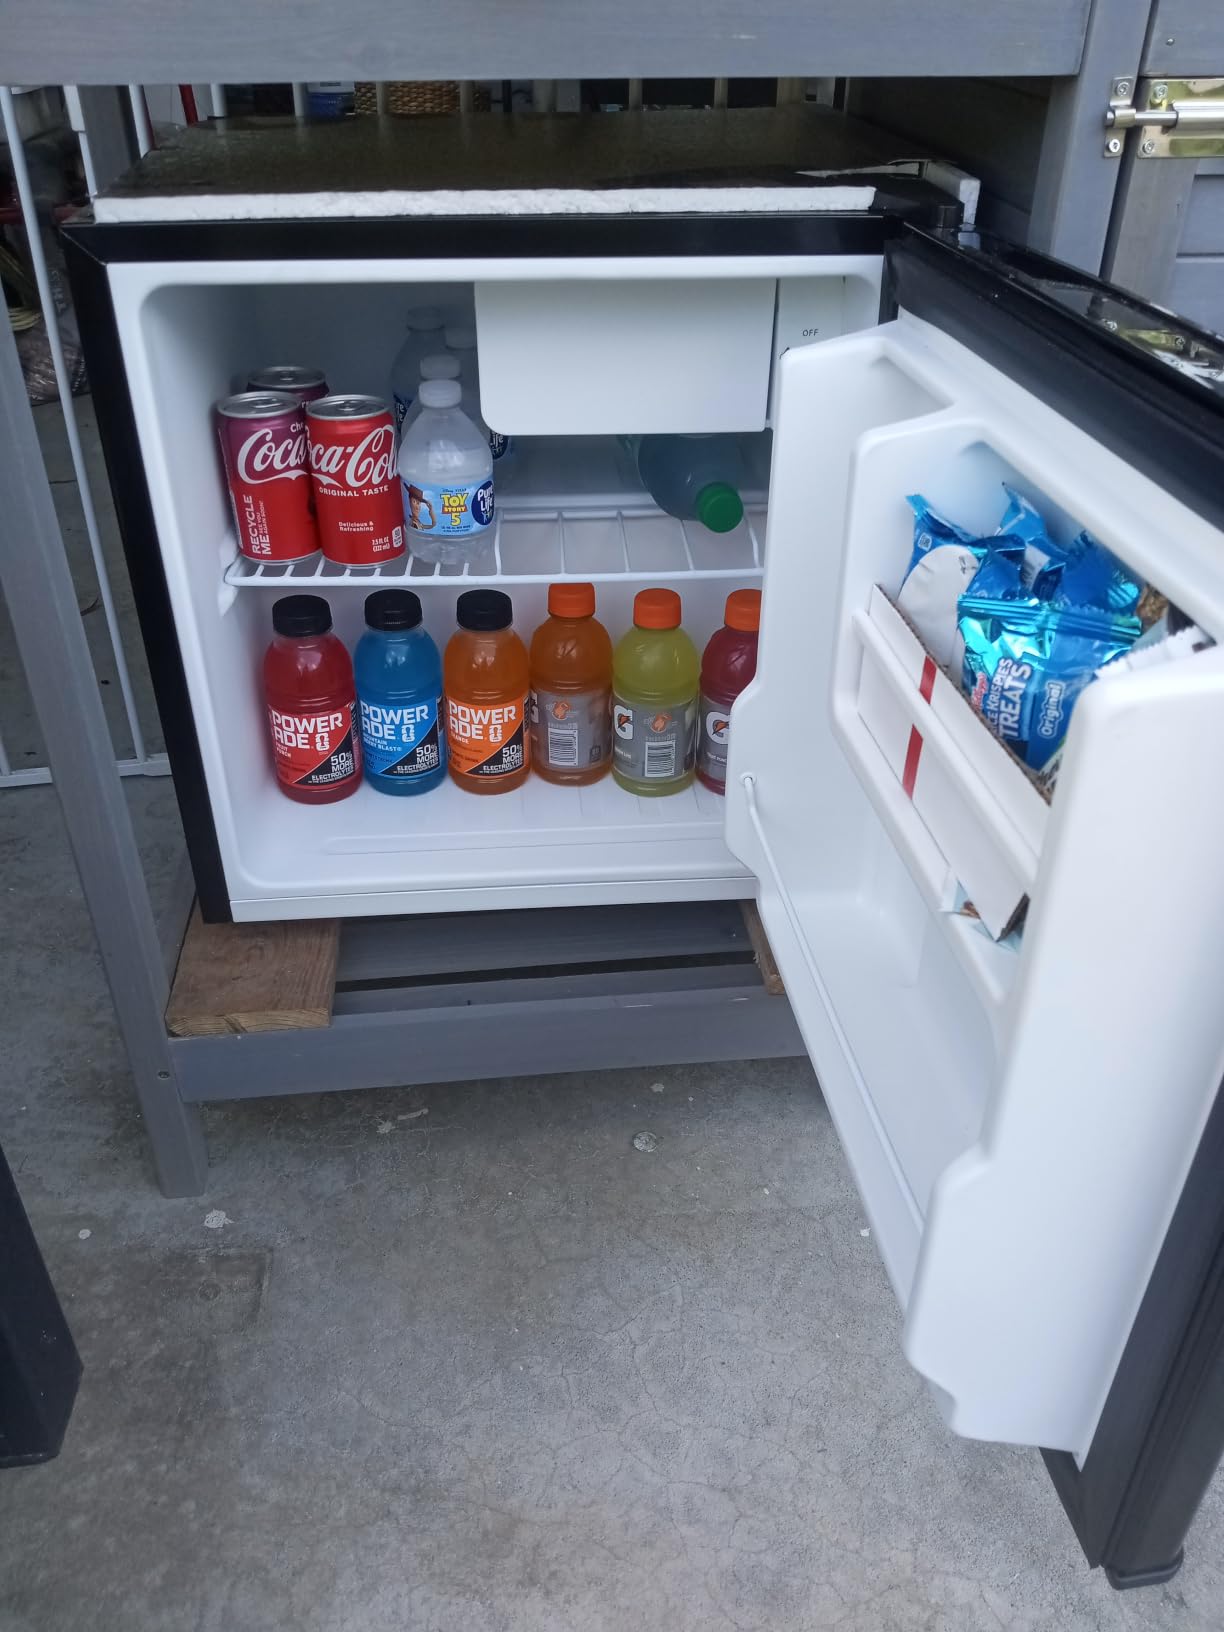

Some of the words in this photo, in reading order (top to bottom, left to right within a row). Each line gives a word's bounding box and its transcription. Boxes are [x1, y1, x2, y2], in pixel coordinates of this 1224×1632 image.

[802, 328, 819, 337] OFF
[318, 486, 360, 497] ORIGINAL
[362, 484, 389, 496] TASTE
[440, 493, 469, 507] TOY
[477, 485, 493, 502] Pure
[480, 496, 493, 513] Life
[243, 494, 261, 555] RECYCLE
[451, 512, 462, 527] 5
[259, 534, 273, 555] ME
[986, 658, 1014, 711] KRISPIES
[999, 663, 1032, 738] TREATS
[1041, 682, 1063, 736] Original
[271, 709, 344, 734] POWER
[360, 700, 429, 725] POWER
[448, 699, 516, 725] POWER
[361, 716, 396, 740] ADE
[450, 715, 484, 740] ADE
[614, 704, 634, 740] G
[273, 725, 311, 750] ADE
[330, 750, 353, 766] 50%
[416, 743, 438, 757] 50%
[416, 752, 439, 765] MORE
[502, 743, 523, 757] 50%
[502, 752, 523, 765] MORE
[331, 759, 354, 774] MORE
